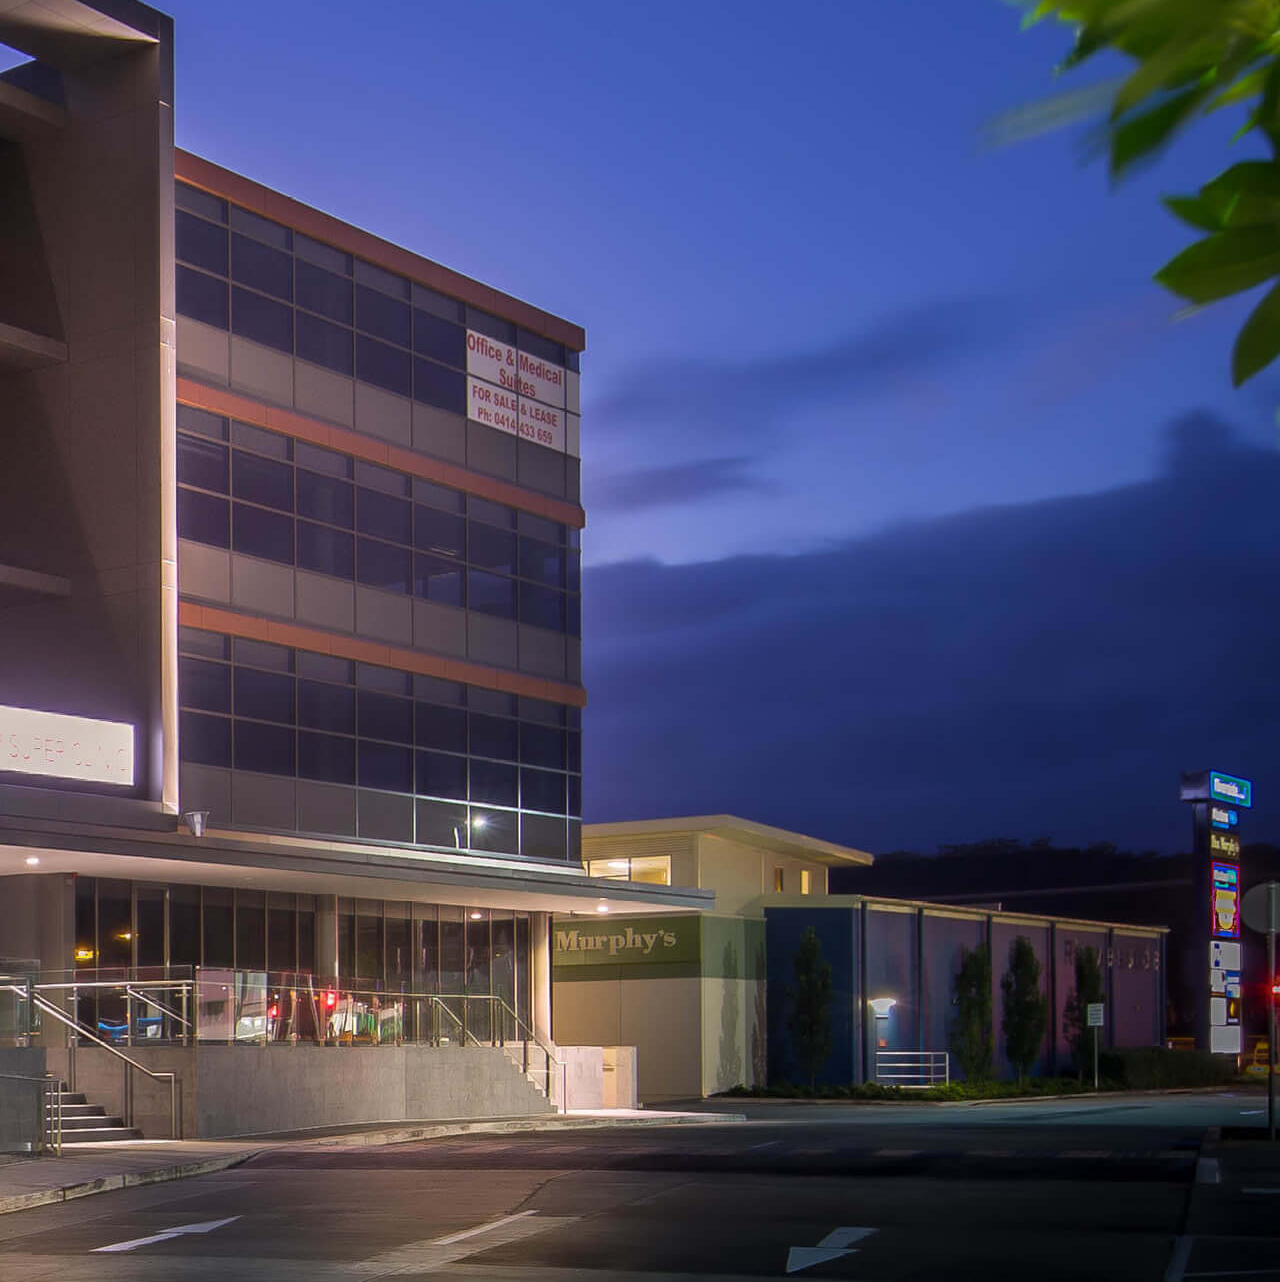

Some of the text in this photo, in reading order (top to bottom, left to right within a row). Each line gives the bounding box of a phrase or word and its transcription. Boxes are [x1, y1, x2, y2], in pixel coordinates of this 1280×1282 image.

[467, 333, 562, 386] Office & Medical
[499, 368, 536, 397] Suites
[472, 385, 558, 427] FOR SALE & LEASE
[477, 407, 492, 423] Ph:
[554, 927, 678, 955] Murphy's
